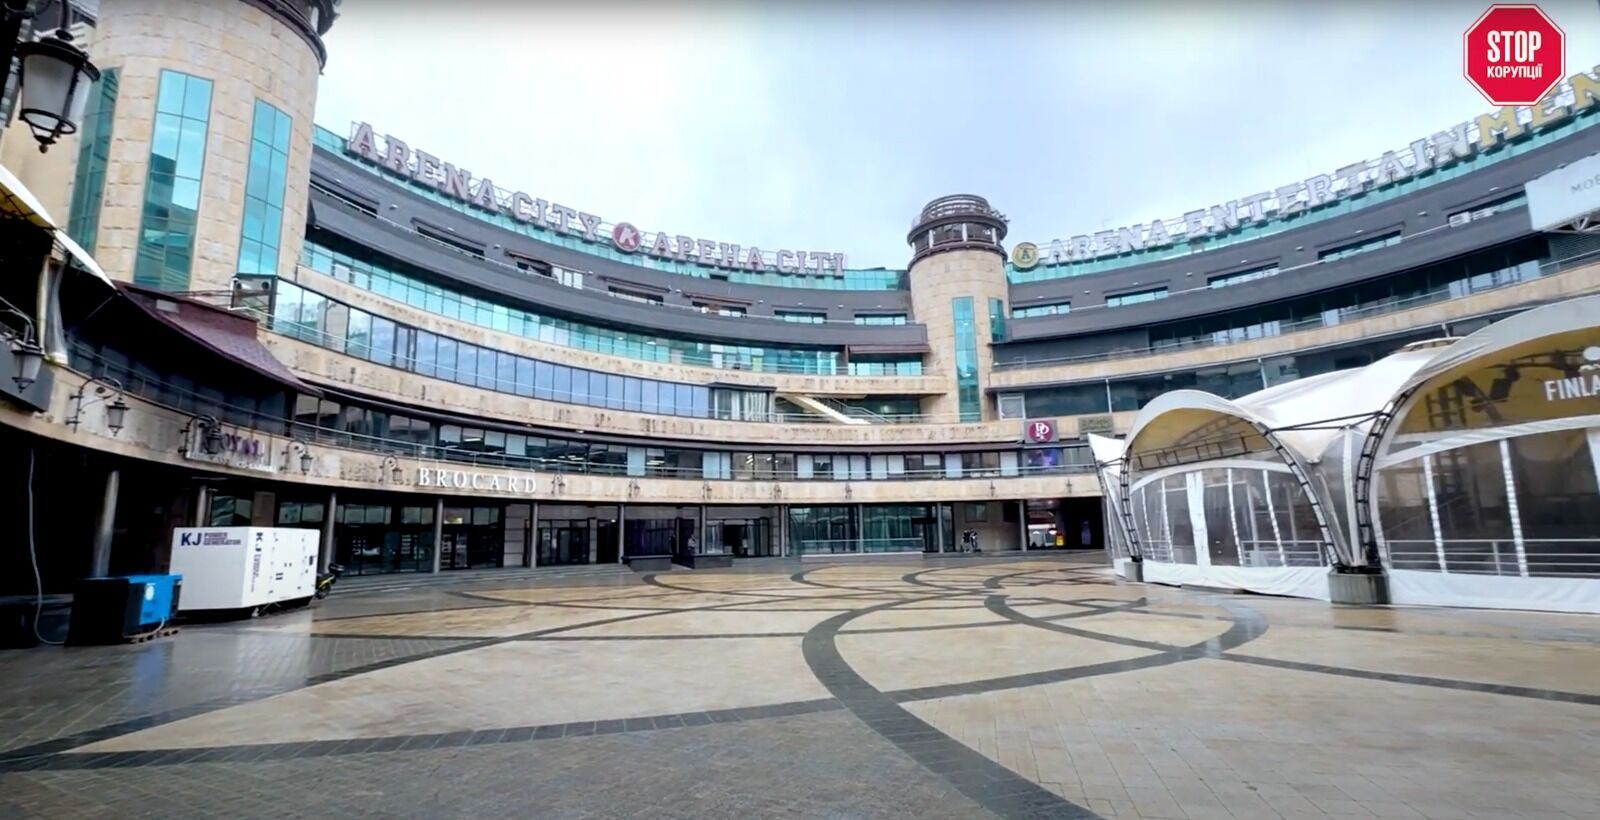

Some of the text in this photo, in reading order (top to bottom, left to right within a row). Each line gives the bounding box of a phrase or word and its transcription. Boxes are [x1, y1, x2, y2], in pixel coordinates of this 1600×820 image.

[351, 121, 602, 242] ARENA CITY
[652, 231, 844, 277] АРЕНА СІТІ
[1048, 219, 1171, 264] ARENA
[420, 467, 537, 493] BROCARD
[181, 532, 202, 546] KJ
